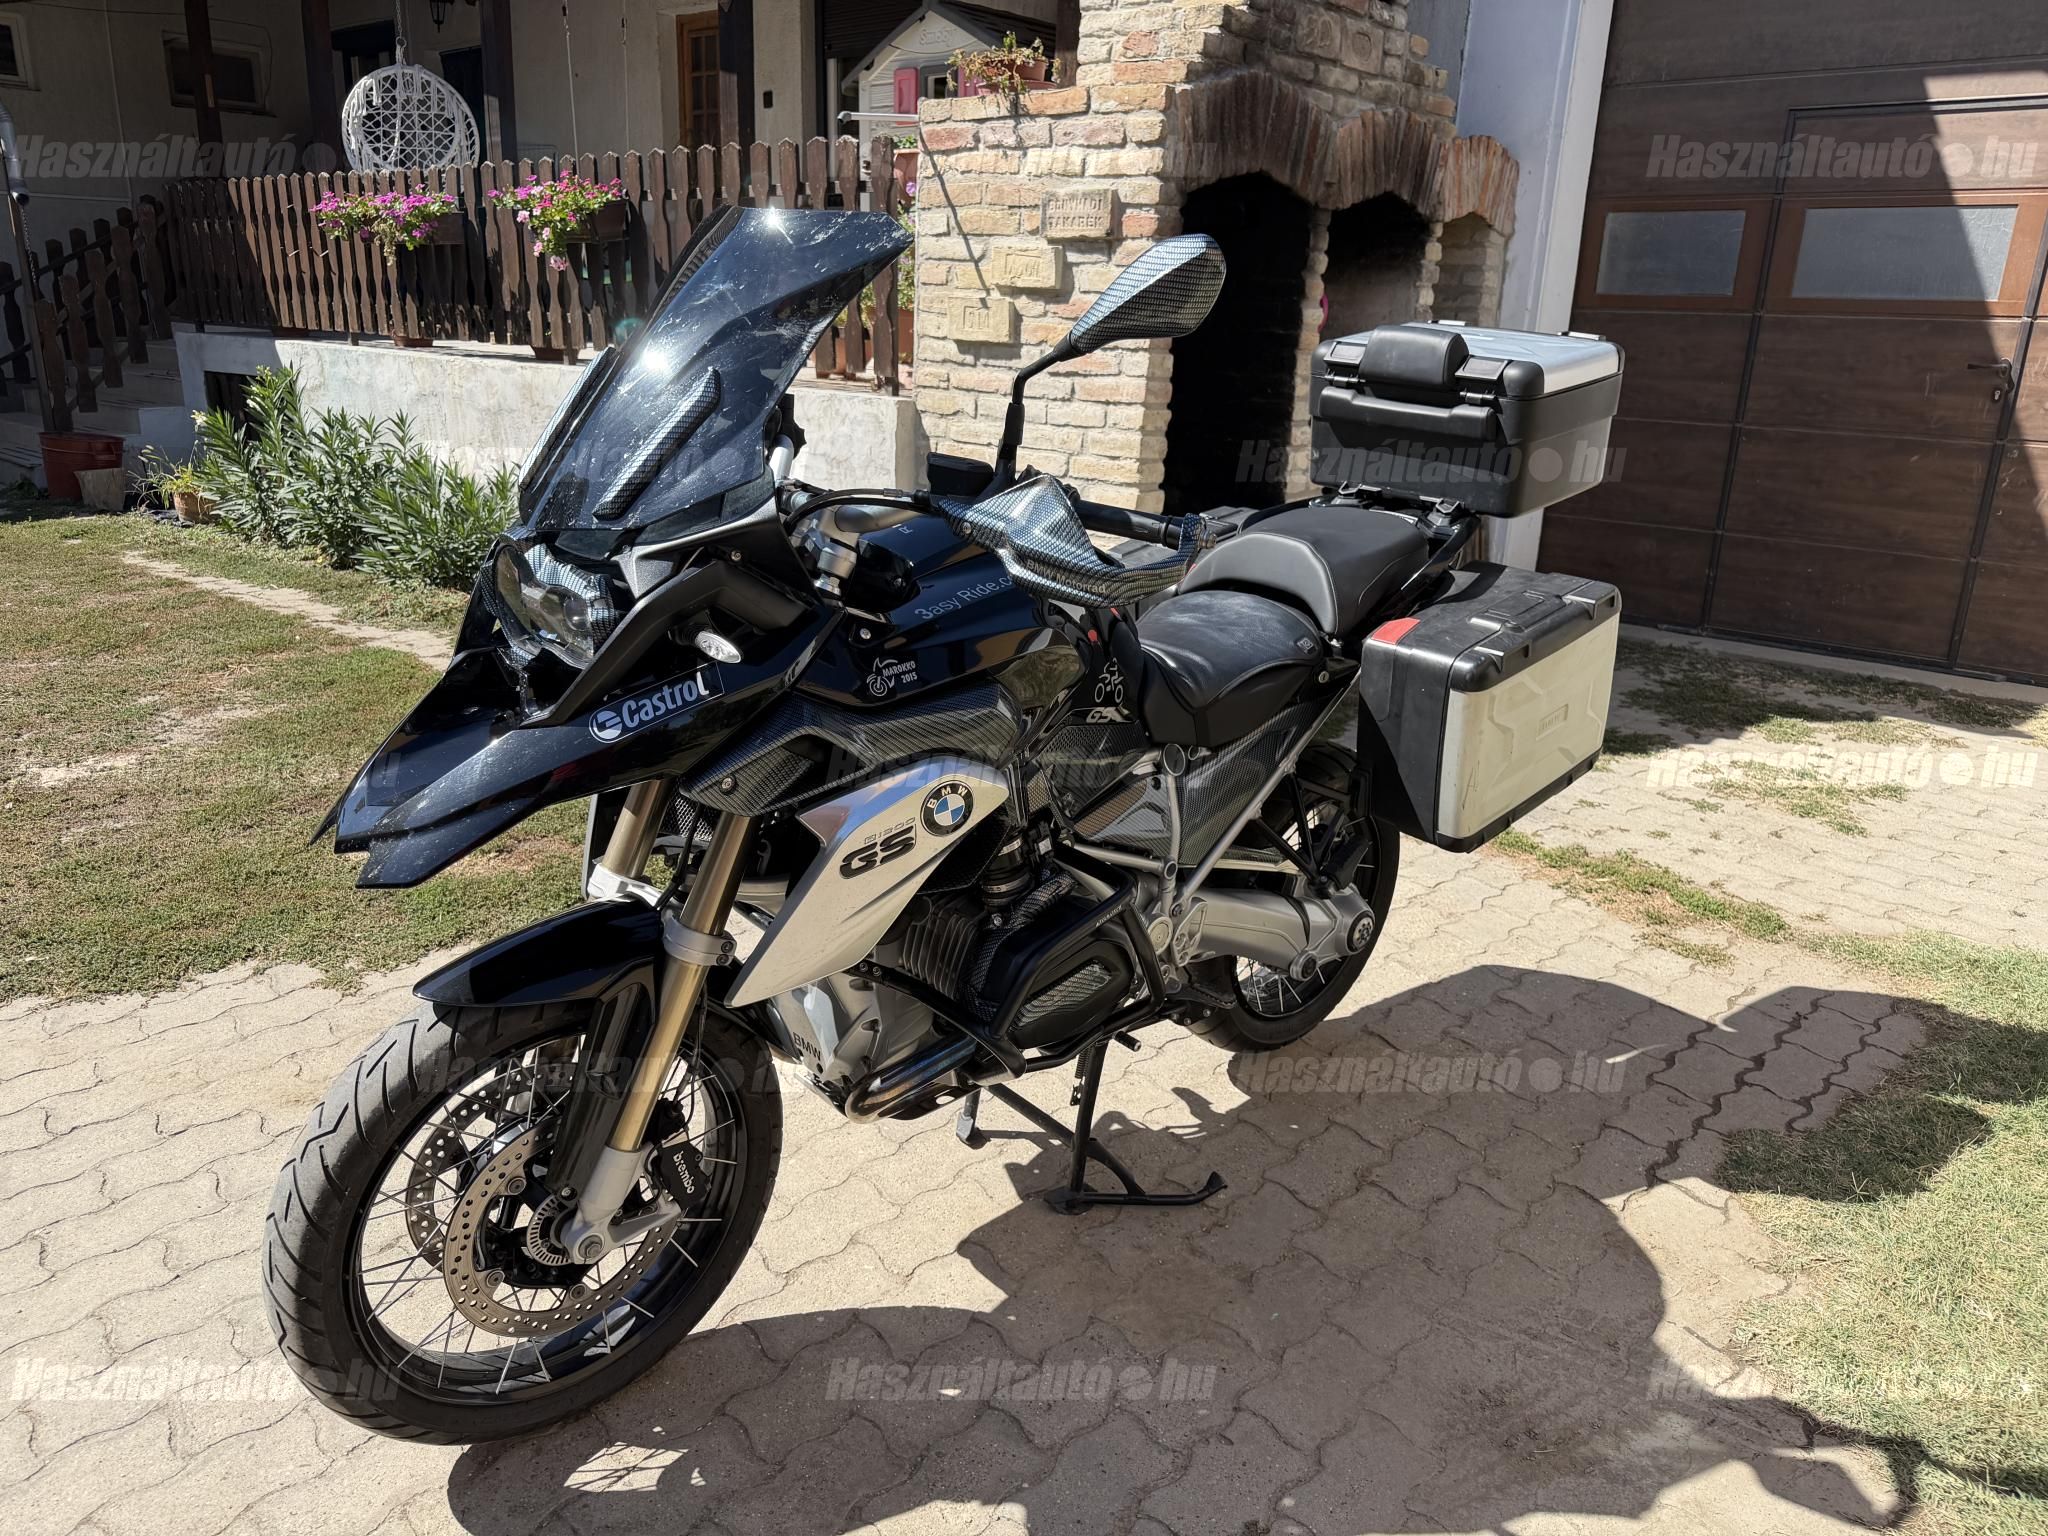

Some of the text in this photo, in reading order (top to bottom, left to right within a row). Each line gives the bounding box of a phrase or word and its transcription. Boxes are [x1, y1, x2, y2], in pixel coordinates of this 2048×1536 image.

[957, 575, 1013, 602] Ride.c
[1026, 558, 1107, 594] BMW Motorrad
[882, 660, 916, 677] MAROKKO
[900, 671, 918, 683] 2015
[621, 671, 710, 728] Castrol
[926, 785, 968, 809] BMW
[839, 824, 917, 880] GS
[792, 1031, 821, 1062] BMW
[673, 1150, 695, 1194] brembo
